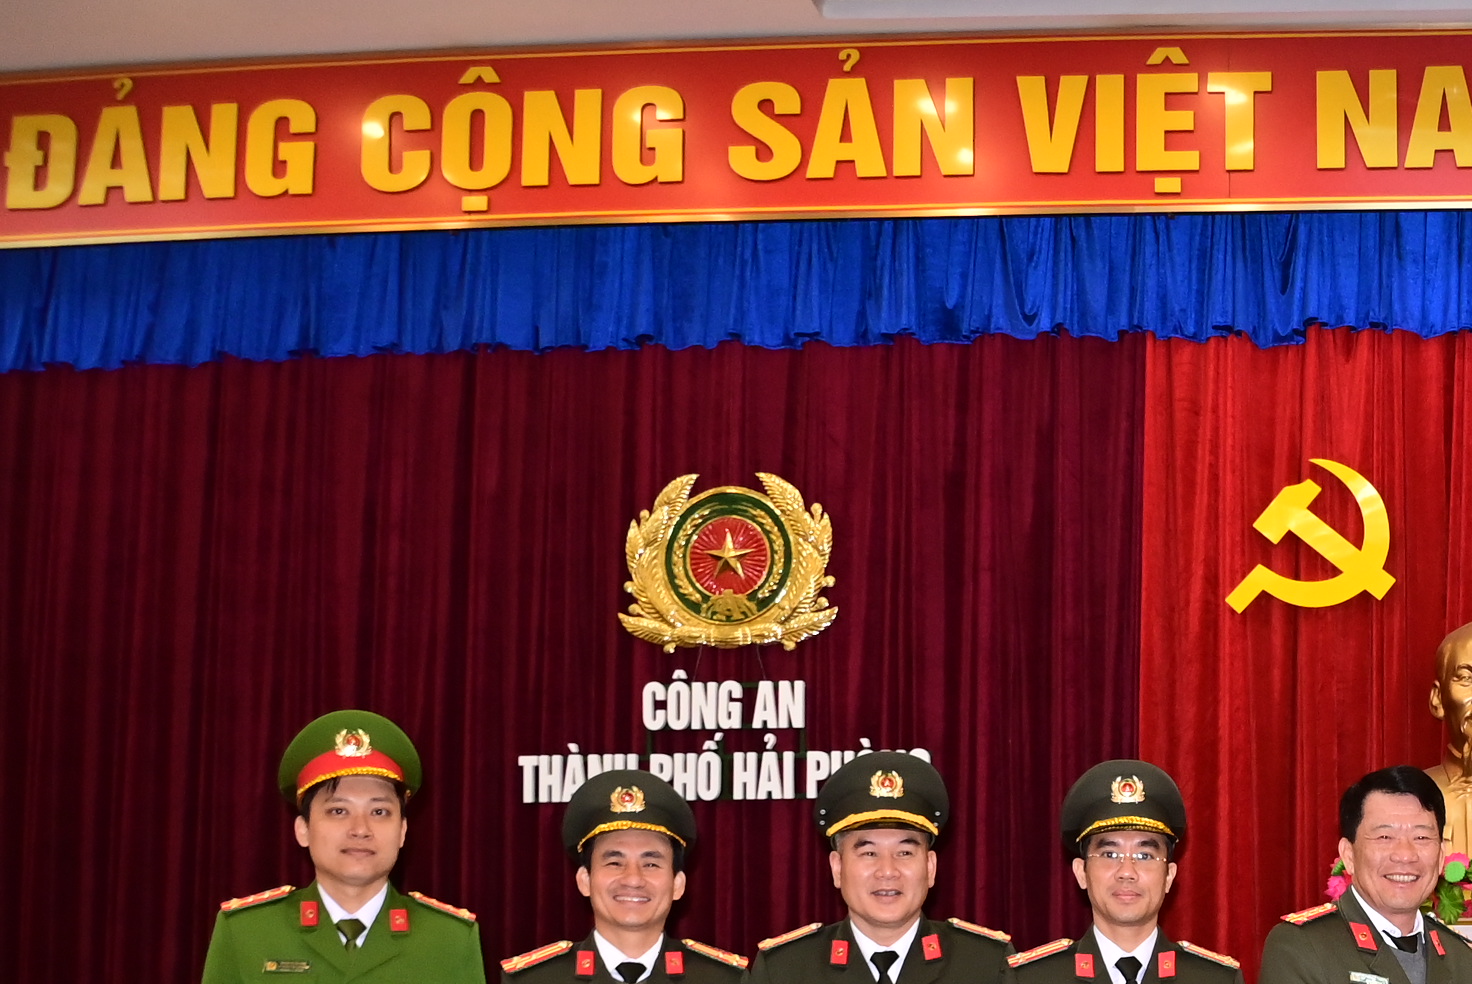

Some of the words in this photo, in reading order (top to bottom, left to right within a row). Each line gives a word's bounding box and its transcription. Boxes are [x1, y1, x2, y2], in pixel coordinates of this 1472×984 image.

[3, 76, 317, 210] ĐẢNG
[360, 66, 687, 213] CỘNG
[727, 48, 977, 181] SẢN
[1016, 46, 1273, 194] VIỆT
[642, 669, 743, 731] CÔNG
[752, 680, 805, 729] AN
[650, 732, 728, 801] PHỐ
[732, 733, 796, 800] HẢI
